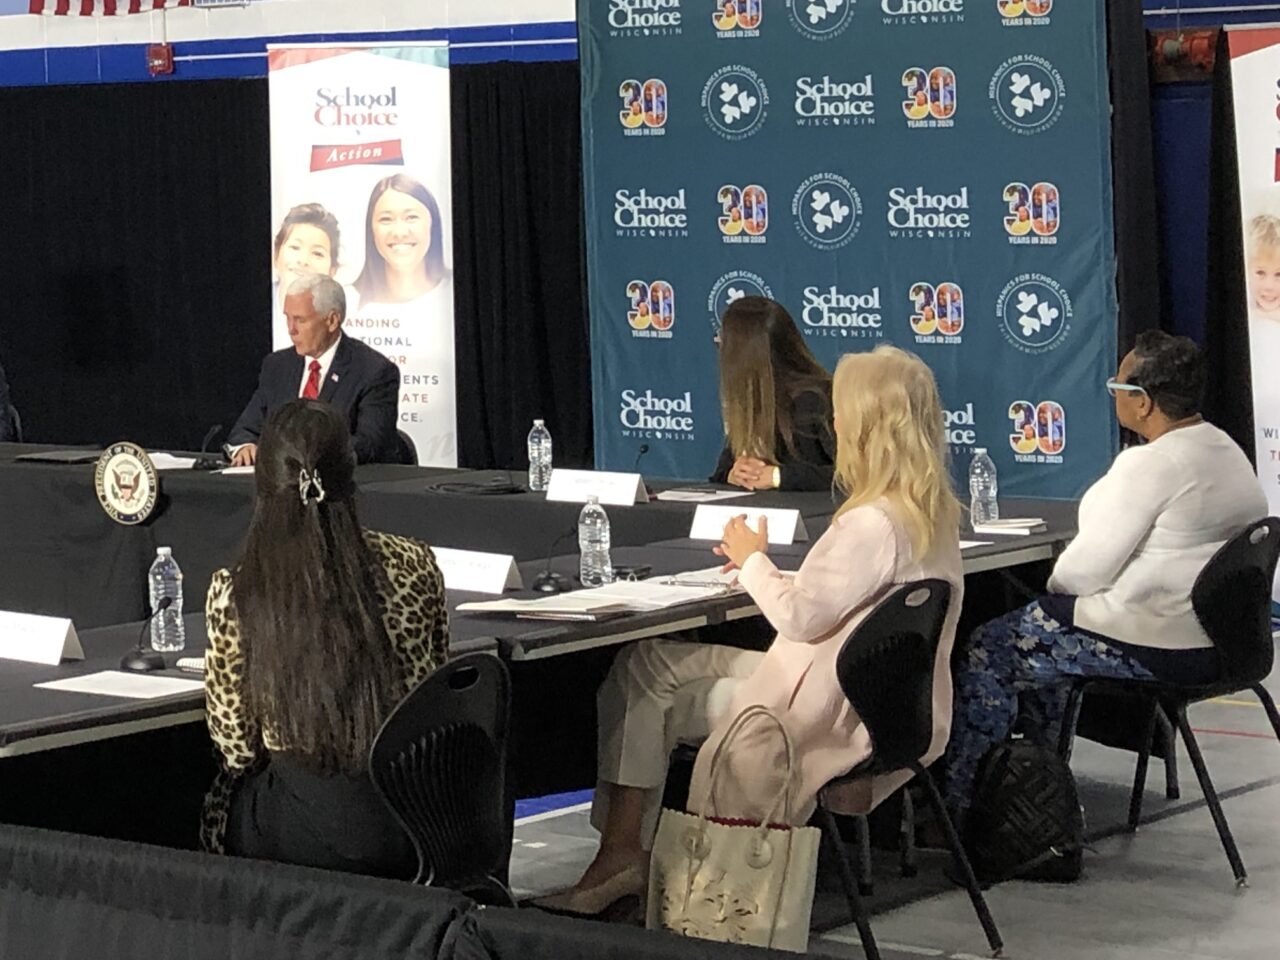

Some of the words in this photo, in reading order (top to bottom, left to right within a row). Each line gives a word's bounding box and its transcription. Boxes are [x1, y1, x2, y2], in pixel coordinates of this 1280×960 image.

[608, 9, 682, 28] Choice
[796, 74, 873, 97] School
[901, 67, 957, 120] 30
[316, 86, 397, 109] School
[619, 78, 667, 128] 30
[795, 96, 874, 116] Choice
[314, 105, 398, 126] Choice
[327, 146, 382, 162] Action
[615, 189, 687, 209] School
[888, 186, 969, 209] School
[614, 208, 687, 228] Choice
[717, 184, 768, 235] 30
[887, 207, 970, 228] Choice
[1003, 182, 1060, 236] 30
[626, 280, 674, 330] 30
[802, 286, 881, 309] School
[802, 306, 882, 327] Choice
[909, 282, 964, 335] 30
[345, 319, 400, 328] ANDING
[360, 337, 412, 346] TIONAL
[390, 356, 407, 365] OR
[403, 375, 439, 385] ENTS
[402, 394, 428, 403] ATE
[621, 390, 692, 413] School
[620, 409, 693, 431] Choice
[941, 403, 976, 426] ool
[944, 429, 976, 444] ice
[1008, 401, 1065, 454] 30
